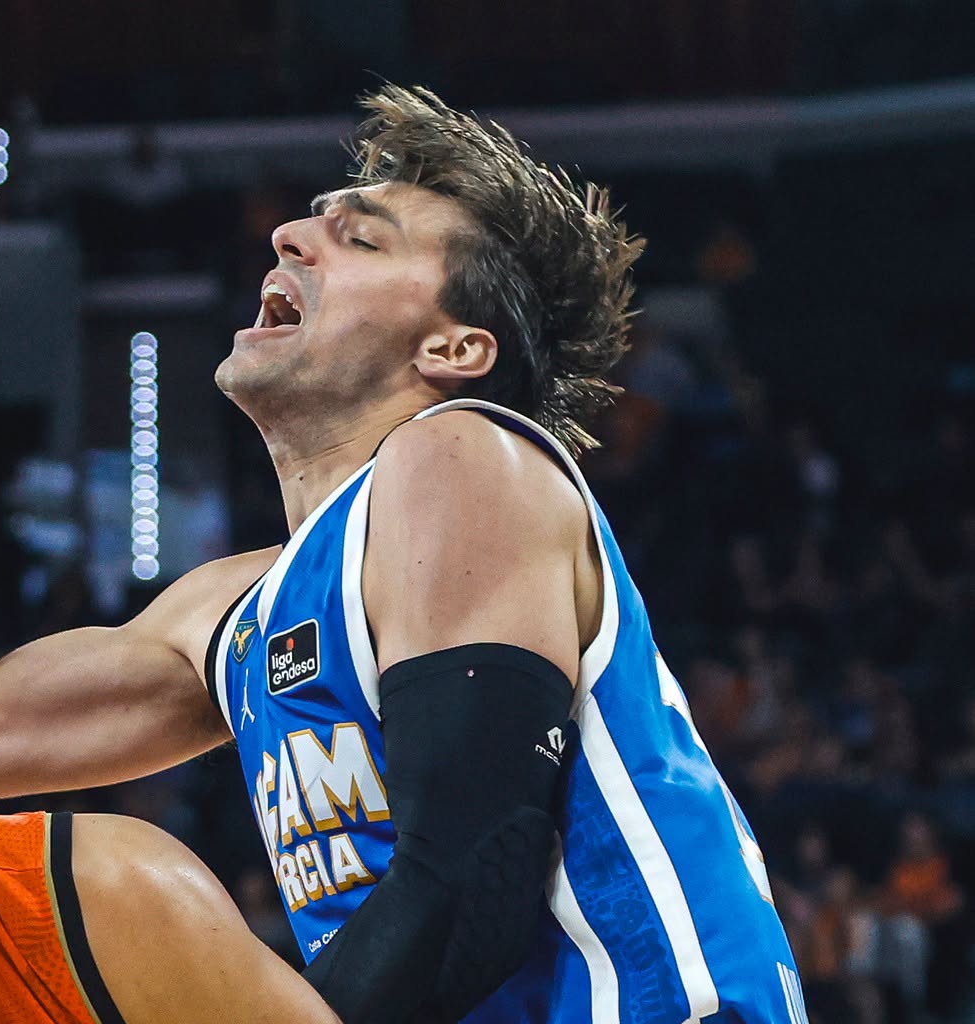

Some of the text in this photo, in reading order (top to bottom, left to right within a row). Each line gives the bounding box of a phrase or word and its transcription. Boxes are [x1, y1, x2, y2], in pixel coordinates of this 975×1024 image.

[271, 651, 293, 670] liga
[272, 657, 316, 685] endesa
[277, 833, 376, 913] RCIA
